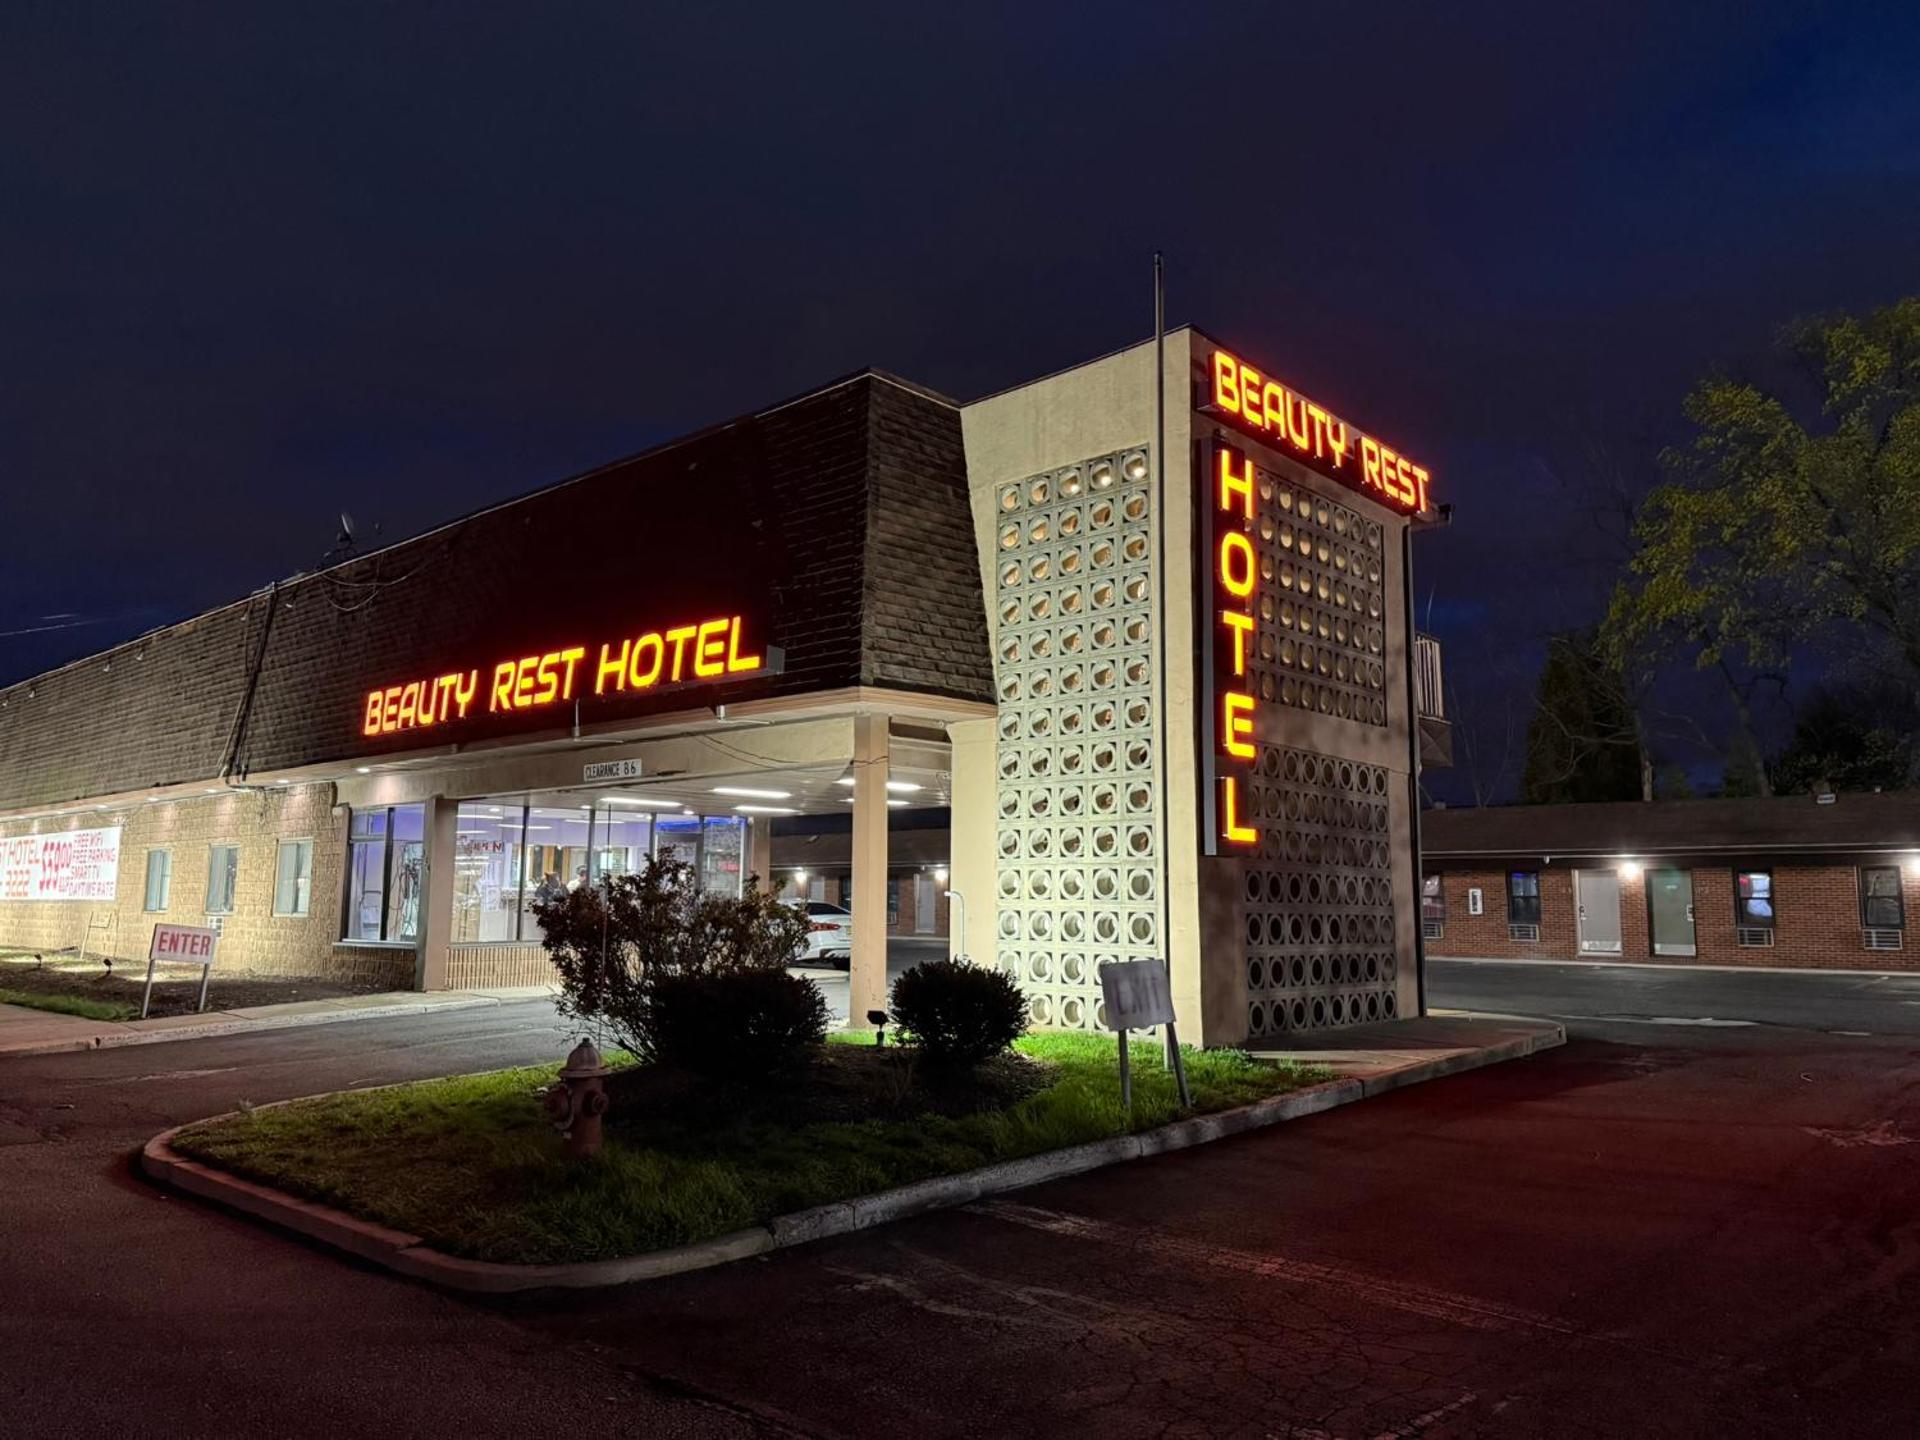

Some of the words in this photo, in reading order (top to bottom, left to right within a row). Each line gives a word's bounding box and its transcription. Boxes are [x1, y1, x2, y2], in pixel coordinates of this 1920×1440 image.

[1213, 349, 1348, 468] BEAUTY
[1361, 435, 1430, 513] REST
[1220, 448, 1258, 843] HOTEL
[363, 668, 479, 736] BEAUTY
[489, 647, 586, 713] REST
[594, 614, 761, 695] HOTEL
[585, 762, 620, 778] CLEARANCE
[7, 838, 40, 866] HOTEL
[72, 849, 88, 863] FREE
[89, 847, 116, 863] PARKING
[71, 865, 90, 880] SMART
[97, 881, 114, 897] RATE
[158, 931, 211, 956] ENTER
